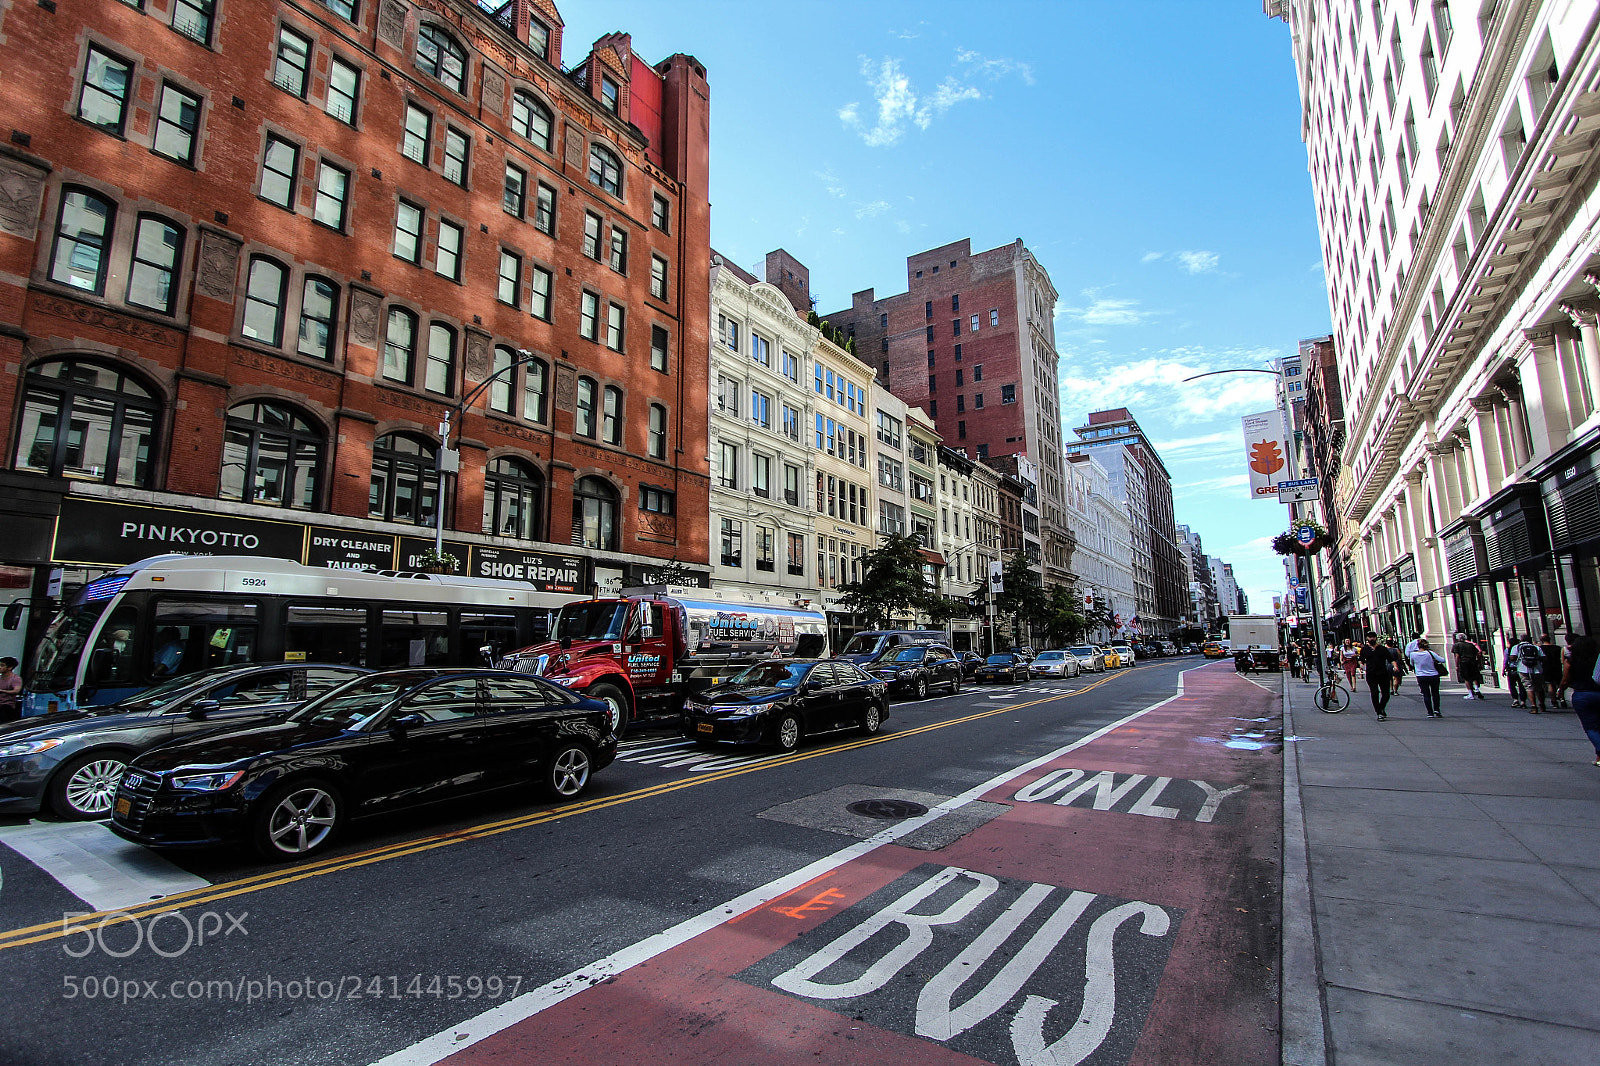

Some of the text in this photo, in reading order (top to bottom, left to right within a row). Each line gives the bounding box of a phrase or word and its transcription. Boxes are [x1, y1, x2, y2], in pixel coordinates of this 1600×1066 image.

[1256, 485, 1279, 494] GRE
[120, 522, 259, 549] PINKYOTTO
[313, 536, 392, 553] DRY CLEANER
[326, 560, 377, 570] TAILORS
[522, 556, 543, 565] LUZ'S
[480, 561, 524, 578] SHOE
[527, 566, 578, 583] REPAIR
[242, 578, 266, 587] 5924
[709, 616, 758, 629] United
[708, 628, 760, 638] FUEL SERVICE
[628, 654, 661, 663] United
[1013, 768, 1250, 823] ONLY
[771, 866, 1170, 1066] BUS
